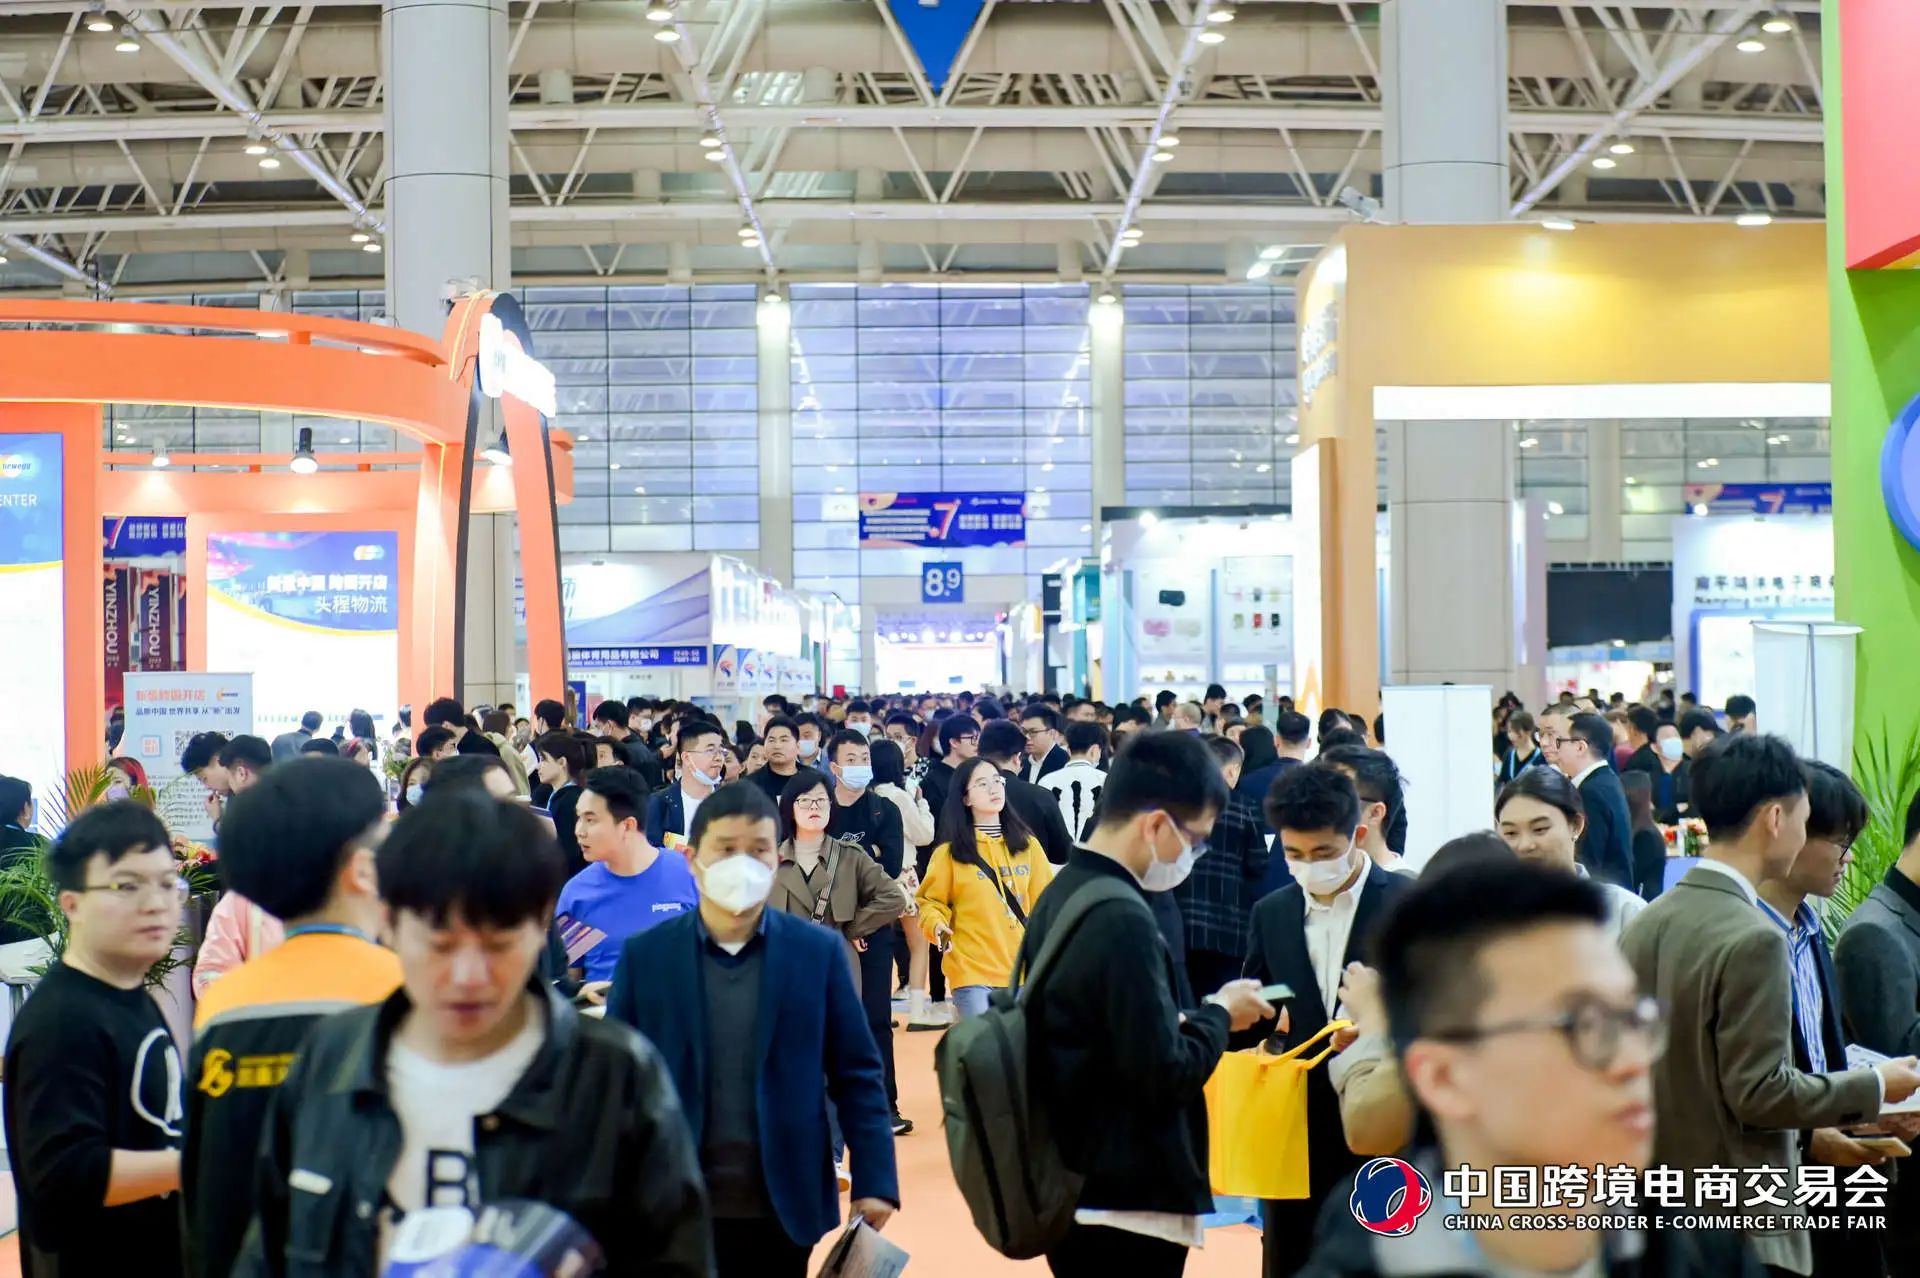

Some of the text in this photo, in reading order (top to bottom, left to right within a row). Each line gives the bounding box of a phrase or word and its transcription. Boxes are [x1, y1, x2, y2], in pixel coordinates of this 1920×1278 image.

[106, 582, 119, 655] YINZHOU
[148, 587, 161, 656] YINZHOU
[315, 595, 388, 614] 头程物流
